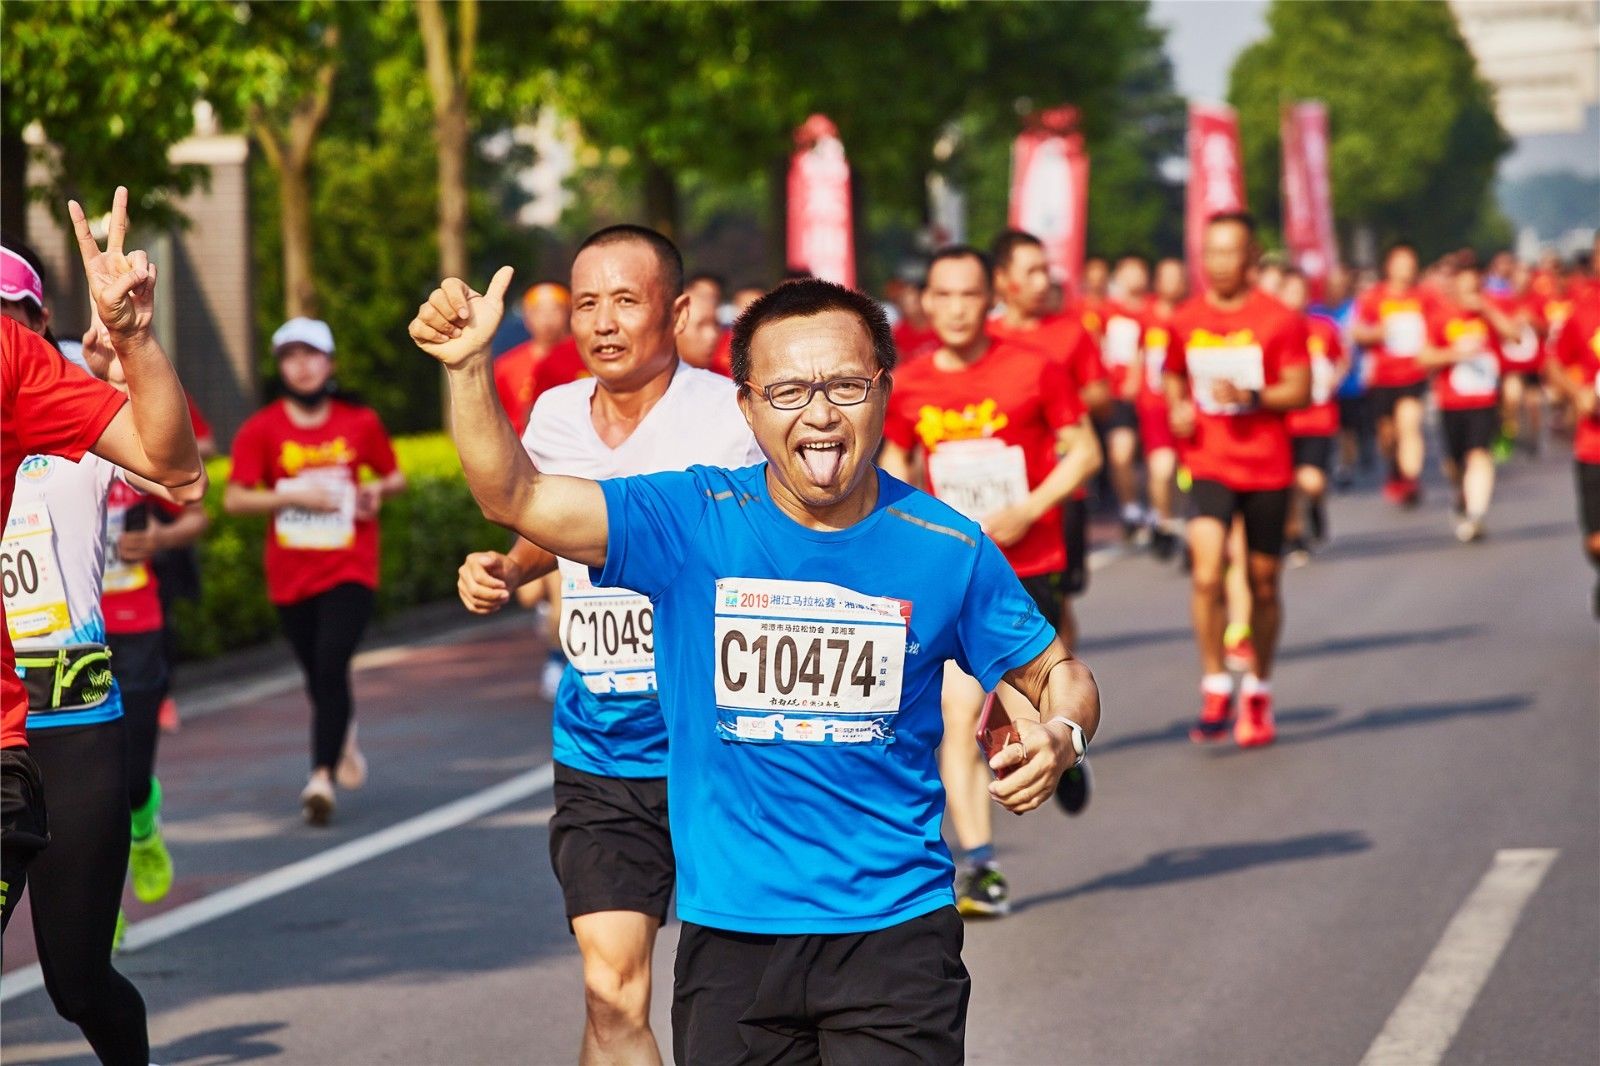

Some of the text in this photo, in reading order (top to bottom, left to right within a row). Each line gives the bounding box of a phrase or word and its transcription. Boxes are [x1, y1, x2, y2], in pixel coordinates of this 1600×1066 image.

[0, 549, 39, 598] 60
[566, 608, 654, 657] C1049
[721, 630, 876, 698] C10474
